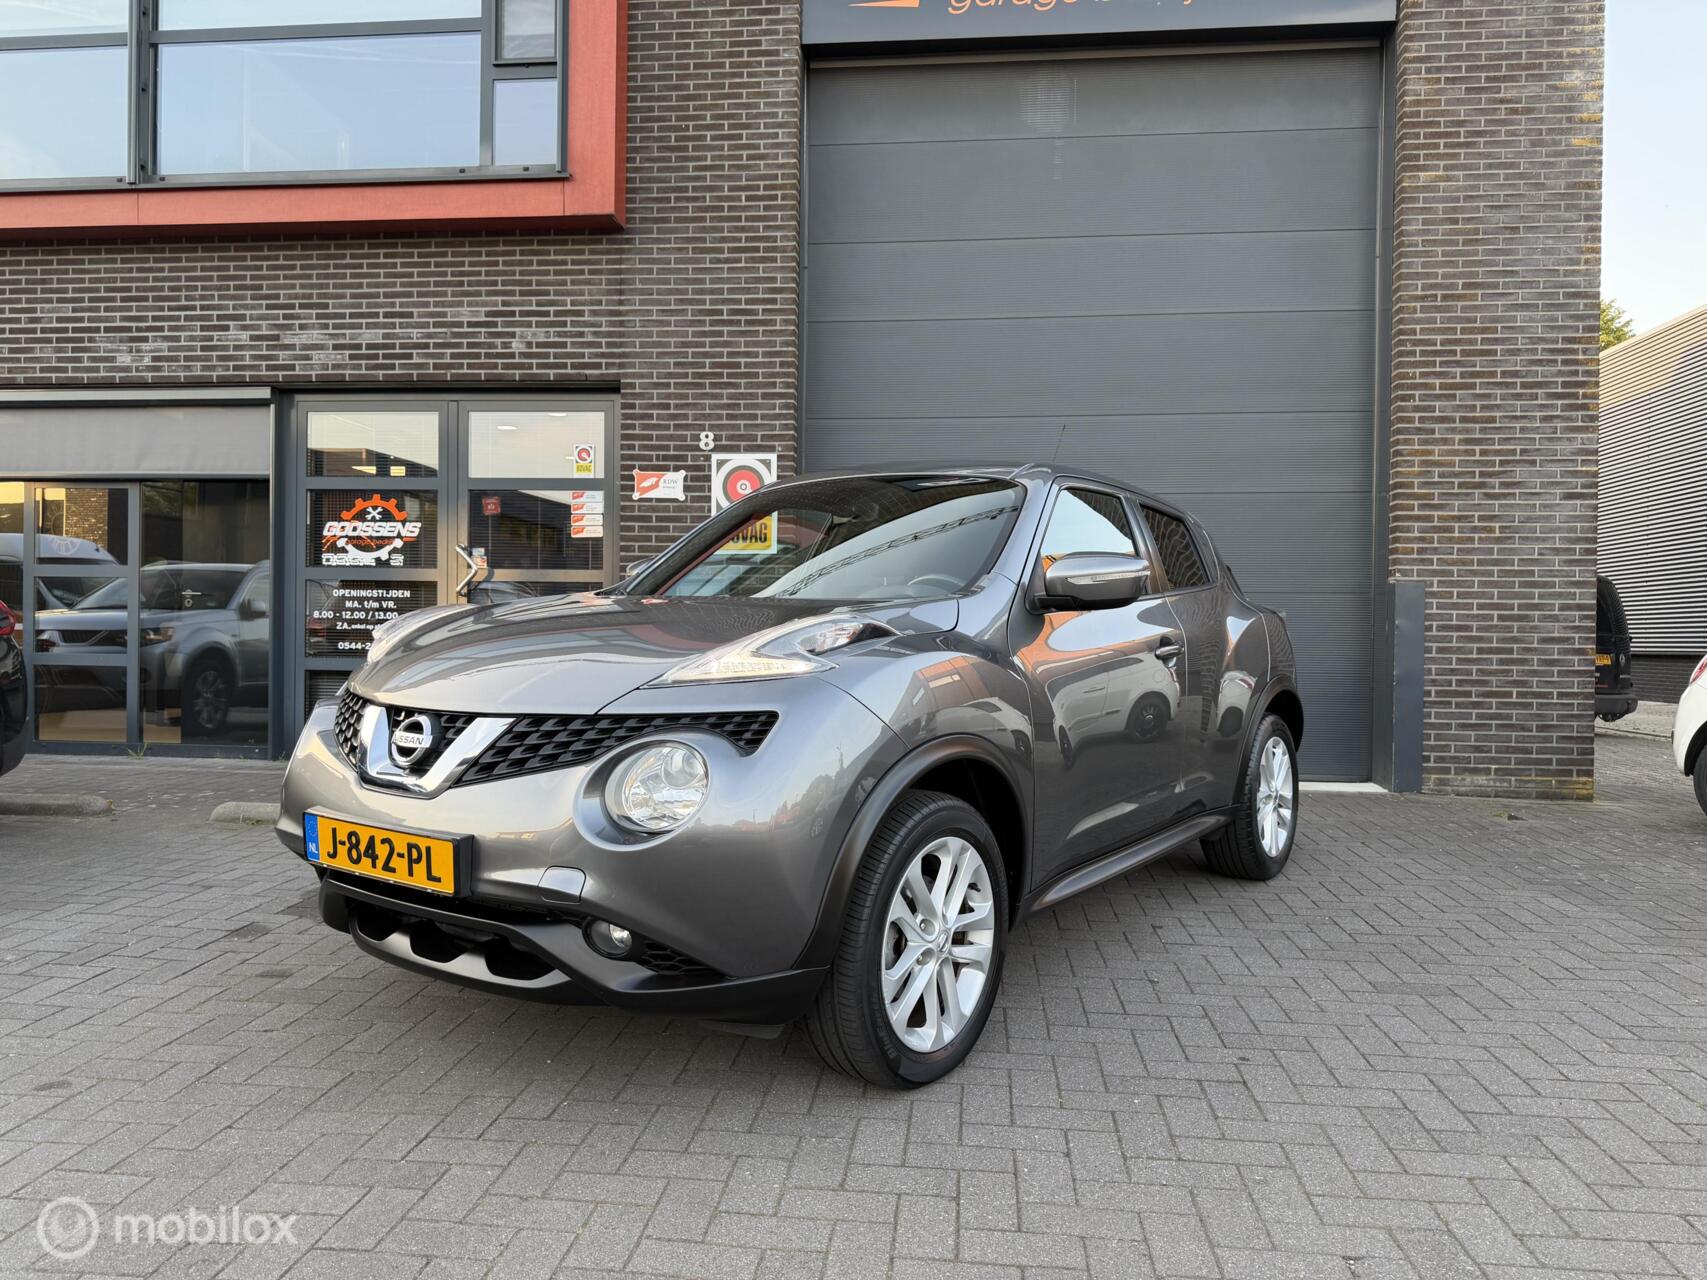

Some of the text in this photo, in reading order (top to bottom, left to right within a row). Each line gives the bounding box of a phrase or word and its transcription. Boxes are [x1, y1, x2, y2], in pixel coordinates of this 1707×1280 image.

[699, 431, 714, 451] 8
[322, 521, 422, 537] GOOSSENS
[333, 589, 411, 598] OPENINGSTIJDEN
[345, 600, 397, 609] MA. t/m VR.
[342, 611, 366, 619] 12.00
[336, 622, 351, 630] ZA.
[338, 642, 372, 650] 0544-2
[308, 841, 319, 854] NL
[327, 827, 441, 883] J-842-PL
